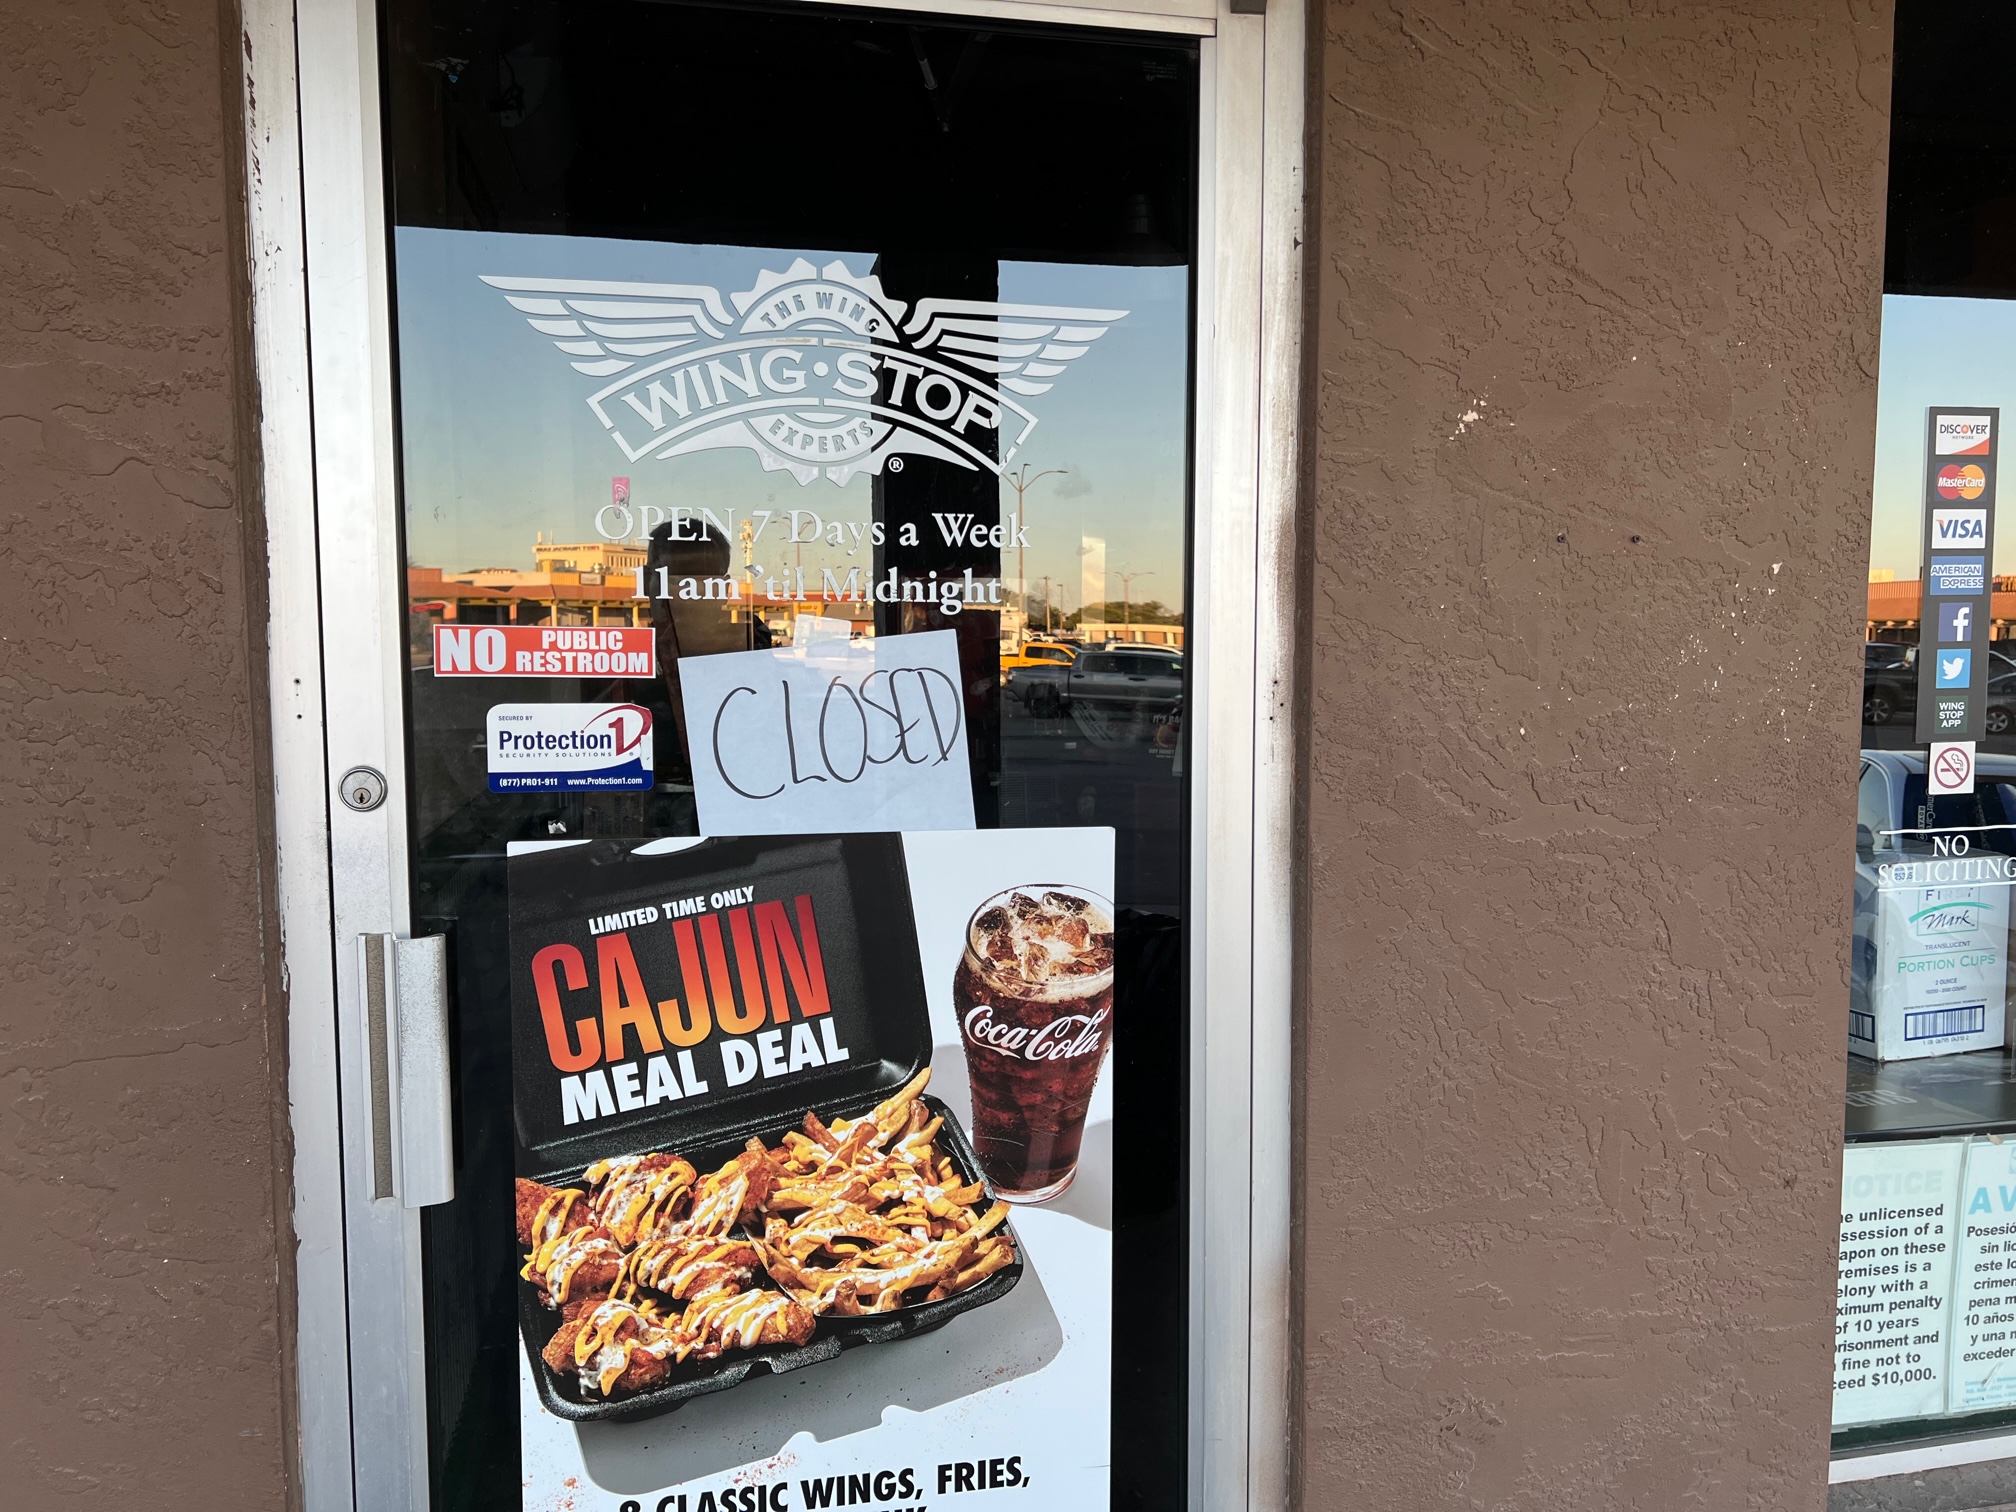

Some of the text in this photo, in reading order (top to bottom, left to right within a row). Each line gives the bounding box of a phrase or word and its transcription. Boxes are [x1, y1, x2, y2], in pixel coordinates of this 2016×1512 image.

[760, 290, 881, 335] THE WING
[768, 418, 875, 454] EXPERTS
[1939, 424, 1988, 435] DISCOVER
[1937, 476, 1985, 488] MasterCard
[594, 504, 1032, 556] OPEN 7 Days a Week
[1936, 519, 1984, 539] VISA
[1931, 565, 1981, 575] AMERICAN
[631, 566, 742, 600] 11am
[821, 566, 1002, 616] Midnight
[1942, 578, 1984, 587] EXPRESS
[439, 628, 623, 672] NO PUBLIC
[515, 651, 649, 674] RESTROOM
[1938, 701, 1965, 711] WING
[1938, 710, 1964, 720] STOP
[713, 667, 962, 800] CLOSED
[1940, 719, 1962, 728] APP
[499, 777, 521, 787] (877)
[567, 776, 643, 786] www.Protection1.com
[1932, 834, 1970, 858] NO
[1878, 857, 2016, 885] SOLICITING
[588, 885, 755, 936] LIMITED TIME ONLY
[1922, 909, 1972, 930] Mark
[1925, 941, 1971, 950] TRANSLUCENT
[1898, 954, 1996, 974] PORTION CUPS
[531, 894, 832, 1073] CAJUN
[1939, 977, 1958, 985] OUNCE
[964, 1003, 1112, 1062] Coca-Cola
[560, 1016, 850, 1126] MEAL DEAL
[1859, 1203, 1944, 1222] unlicensed
[1841, 1222, 1944, 1242] ssession of a
[1839, 1242, 1946, 1263] apon on these
[1980, 1242, 1999, 1254] sin
[1838, 1260, 1932, 1280] remises is a
[1974, 1260, 2003, 1272] este
[1837, 1279, 1928, 1298] elony with a
[1836, 1295, 1943, 1316] ximum penalty
[1968, 1297, 2001, 1311] pena
[1854, 1319, 1872, 1333] 10
[1877, 1317, 1920, 1334] years
[1964, 1312, 2015, 1327] 10 años
[1913, 1330, 1939, 1345] and
[1970, 1334, 1979, 1347] y
[1982, 1331, 2006, 1342] una
[1841, 1352, 1921, 1371] fine not to
[1963, 1347, 2016, 1362] exceder
[1871, 1367, 1937, 1387] $10,000.
[656, 1456, 1031, 1512] CLASSIC WINGS, FRIES,
